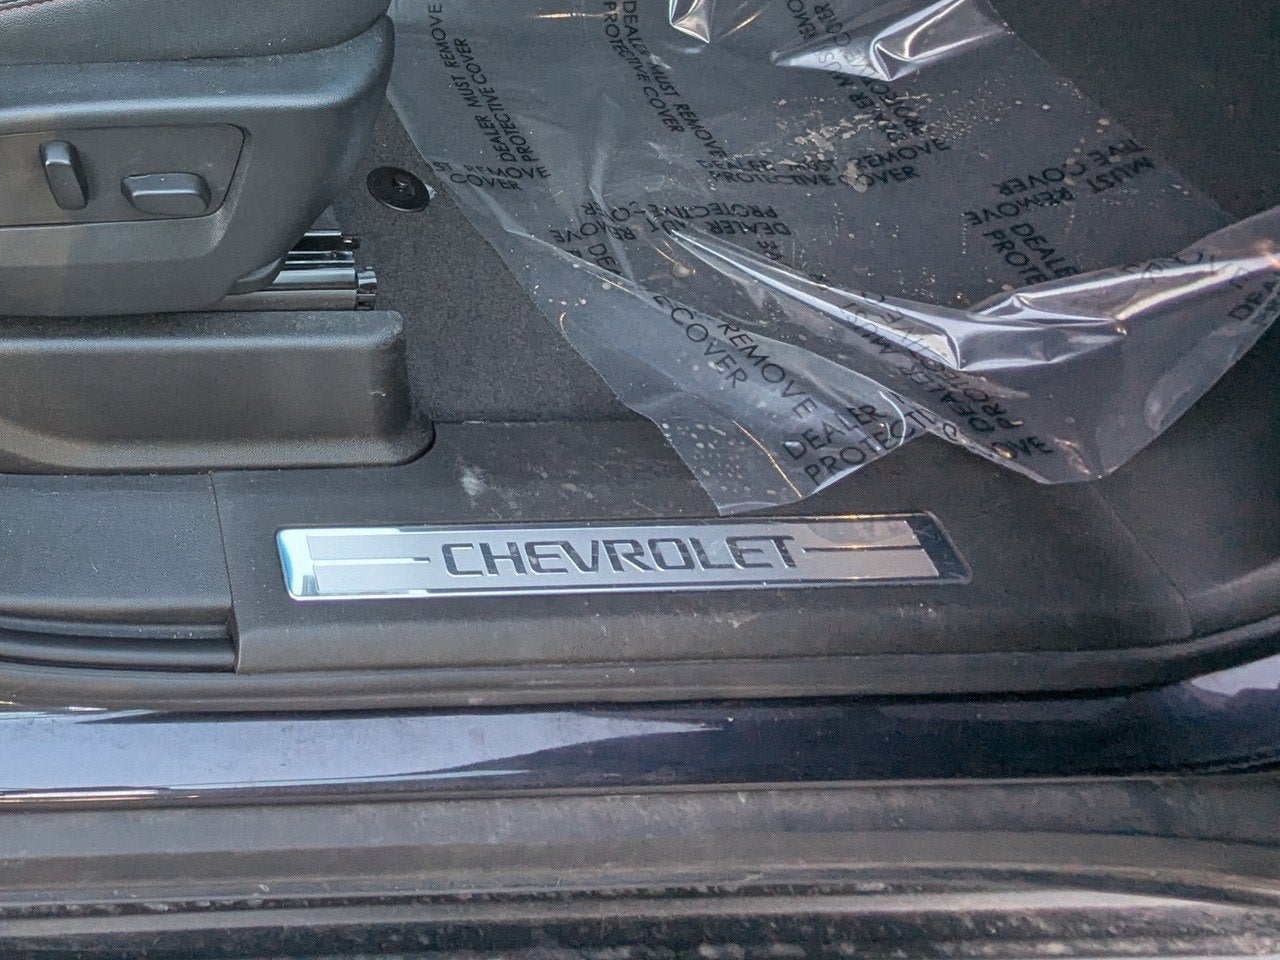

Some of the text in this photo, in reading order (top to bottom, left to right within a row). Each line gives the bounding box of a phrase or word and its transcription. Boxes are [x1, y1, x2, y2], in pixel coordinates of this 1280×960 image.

[428, 3, 518, 163] DEALER MUST REMOVE
[453, 38, 540, 163] PROTECTIVE COVER
[642, 86, 686, 133] COVER
[450, 172, 523, 191] COVER
[705, 219, 792, 236] DEALER
[670, 307, 748, 389] COVER
[717, 323, 819, 419] REMOVE
[782, 403, 888, 460] DEALER
[441, 534, 796, 578] CHEVROLET
